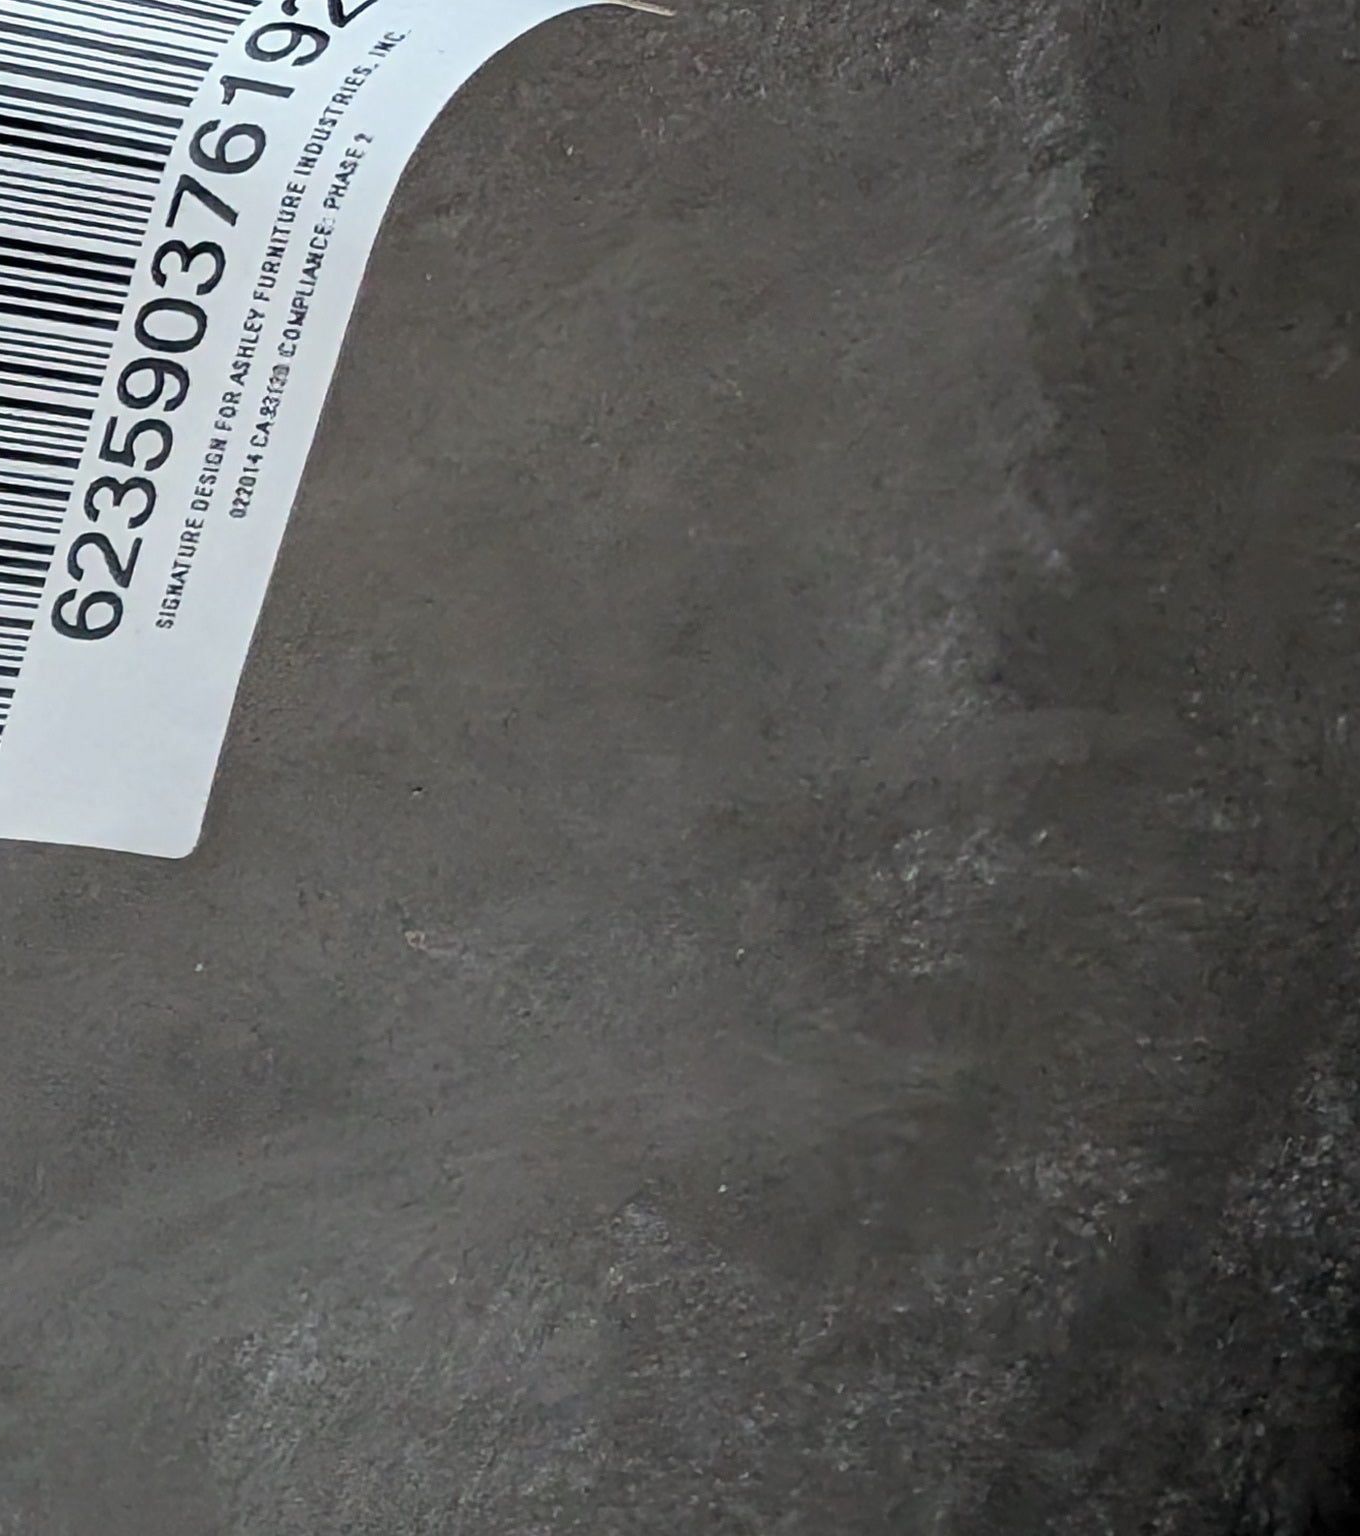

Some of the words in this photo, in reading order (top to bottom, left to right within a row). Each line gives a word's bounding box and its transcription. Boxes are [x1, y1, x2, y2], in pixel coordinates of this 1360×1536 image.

[323, 147, 367, 212] PHASE
[156, 517, 204, 630] SIGNATURE
[190, 438, 228, 513] DESIGN
[216, 390, 242, 433] FOR
[229, 307, 266, 387] ASHLEY
[253, 181, 307, 302] FURNITURE
